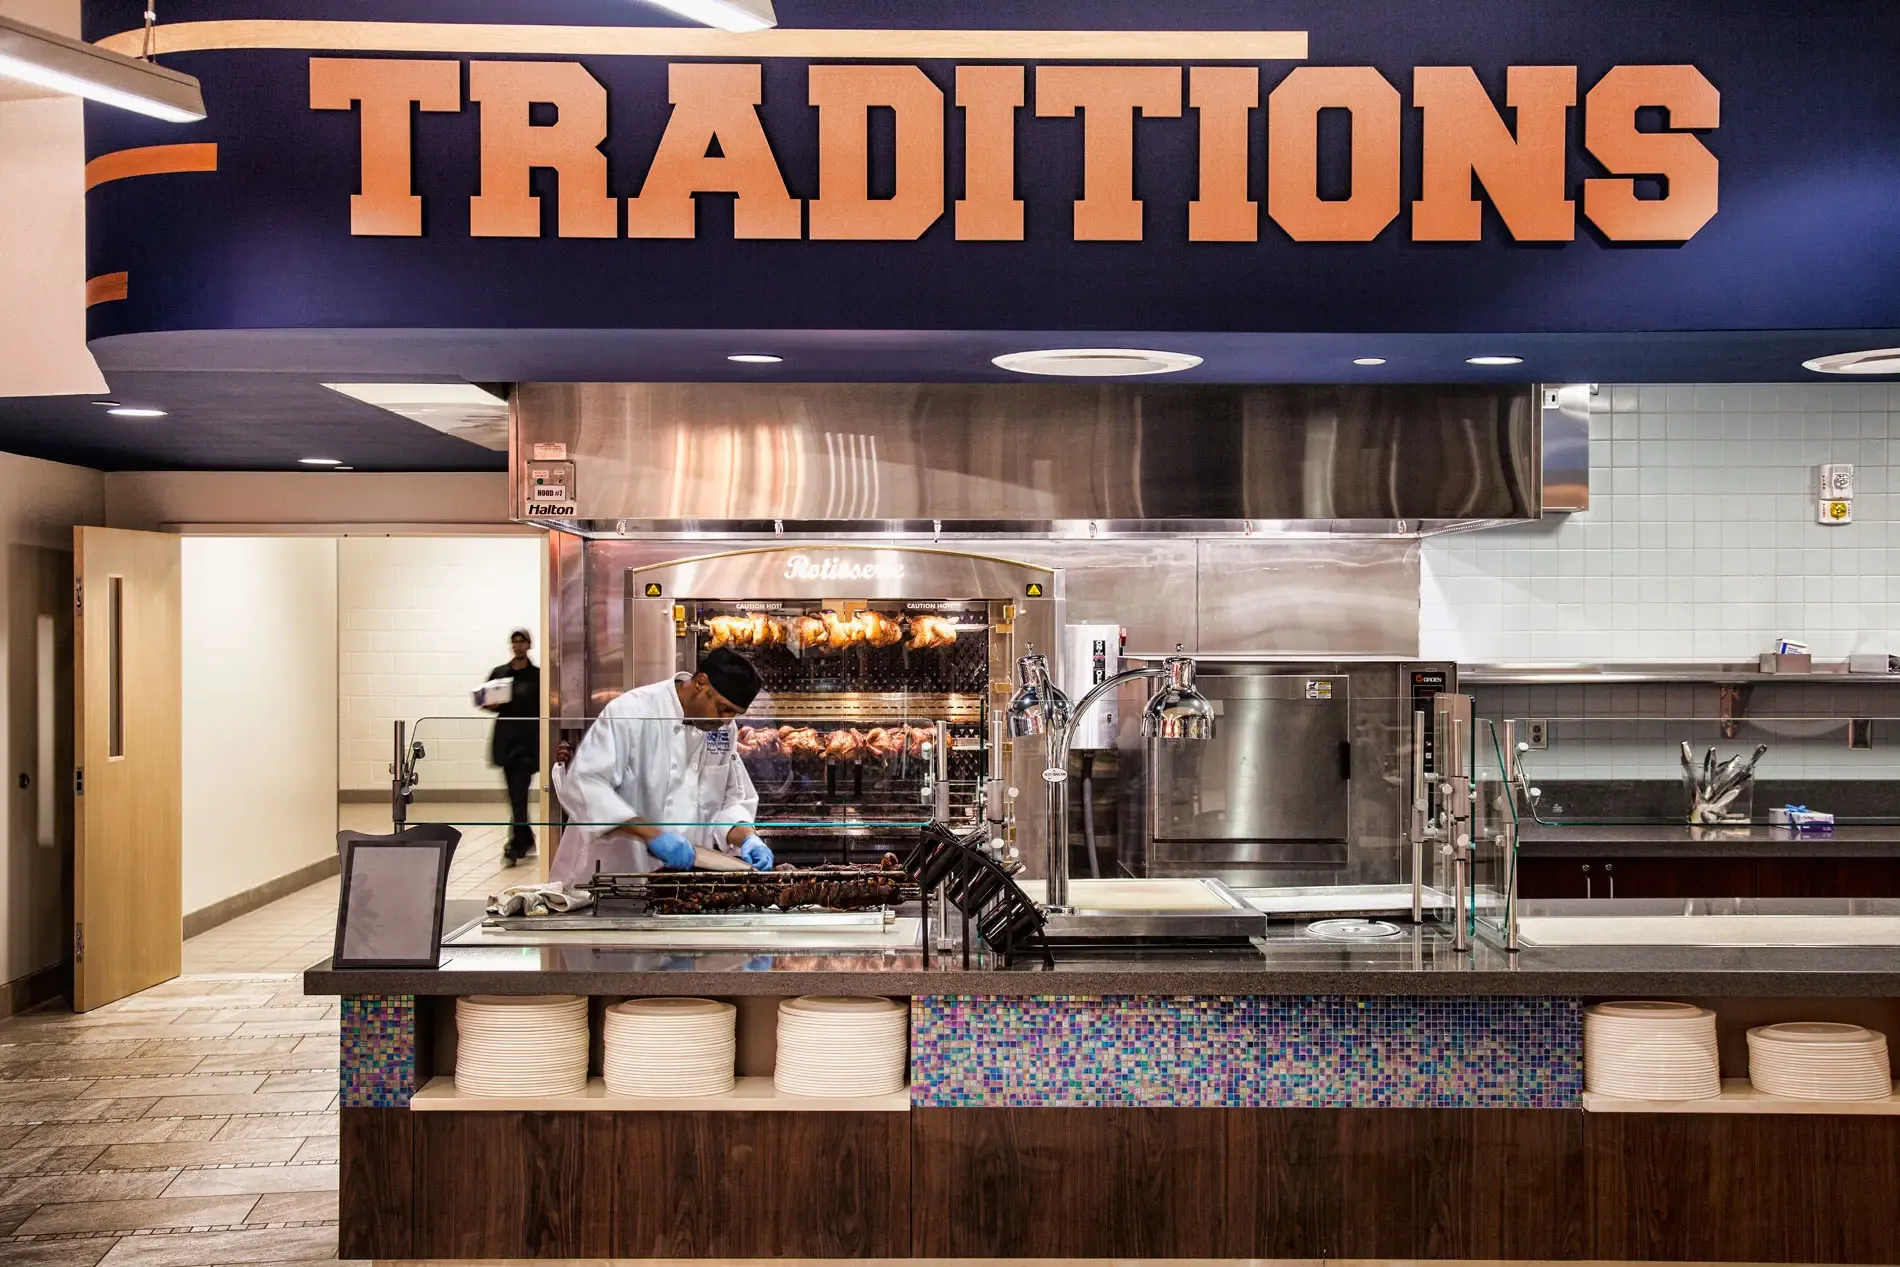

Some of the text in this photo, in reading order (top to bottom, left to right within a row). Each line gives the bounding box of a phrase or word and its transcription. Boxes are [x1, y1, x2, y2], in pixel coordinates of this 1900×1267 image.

[309, 57, 1720, 242] TRADITIONS
[537, 489, 554, 497] HOOD
[528, 504, 574, 515] Halton
[783, 554, 906, 581] Rotissee
